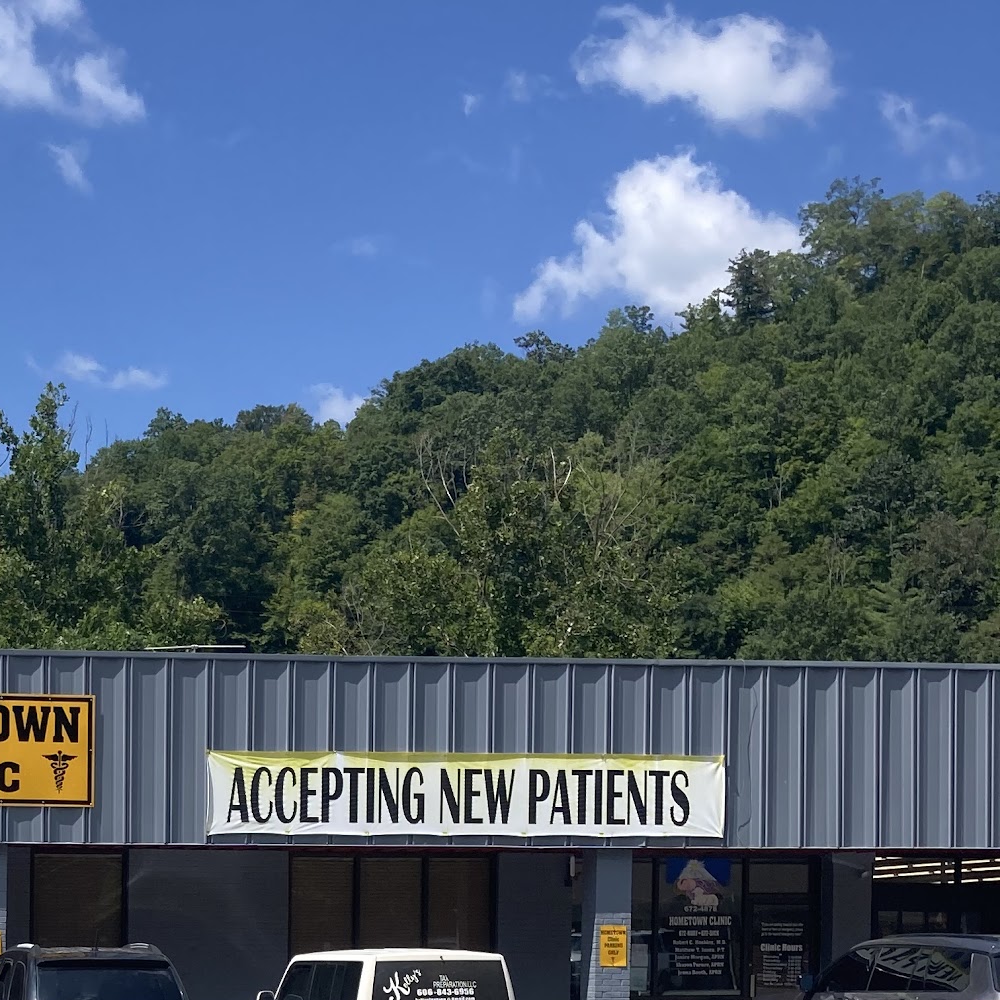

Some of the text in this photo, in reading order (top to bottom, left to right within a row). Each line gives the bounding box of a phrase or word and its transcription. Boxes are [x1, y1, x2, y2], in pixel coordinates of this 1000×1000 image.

[227, 766, 690, 827] ACCEPTING NEW PATIENTS
[668, 916, 732, 926] HOMETOWN CLINIC
[760, 943, 803, 951] Clinic Hours
